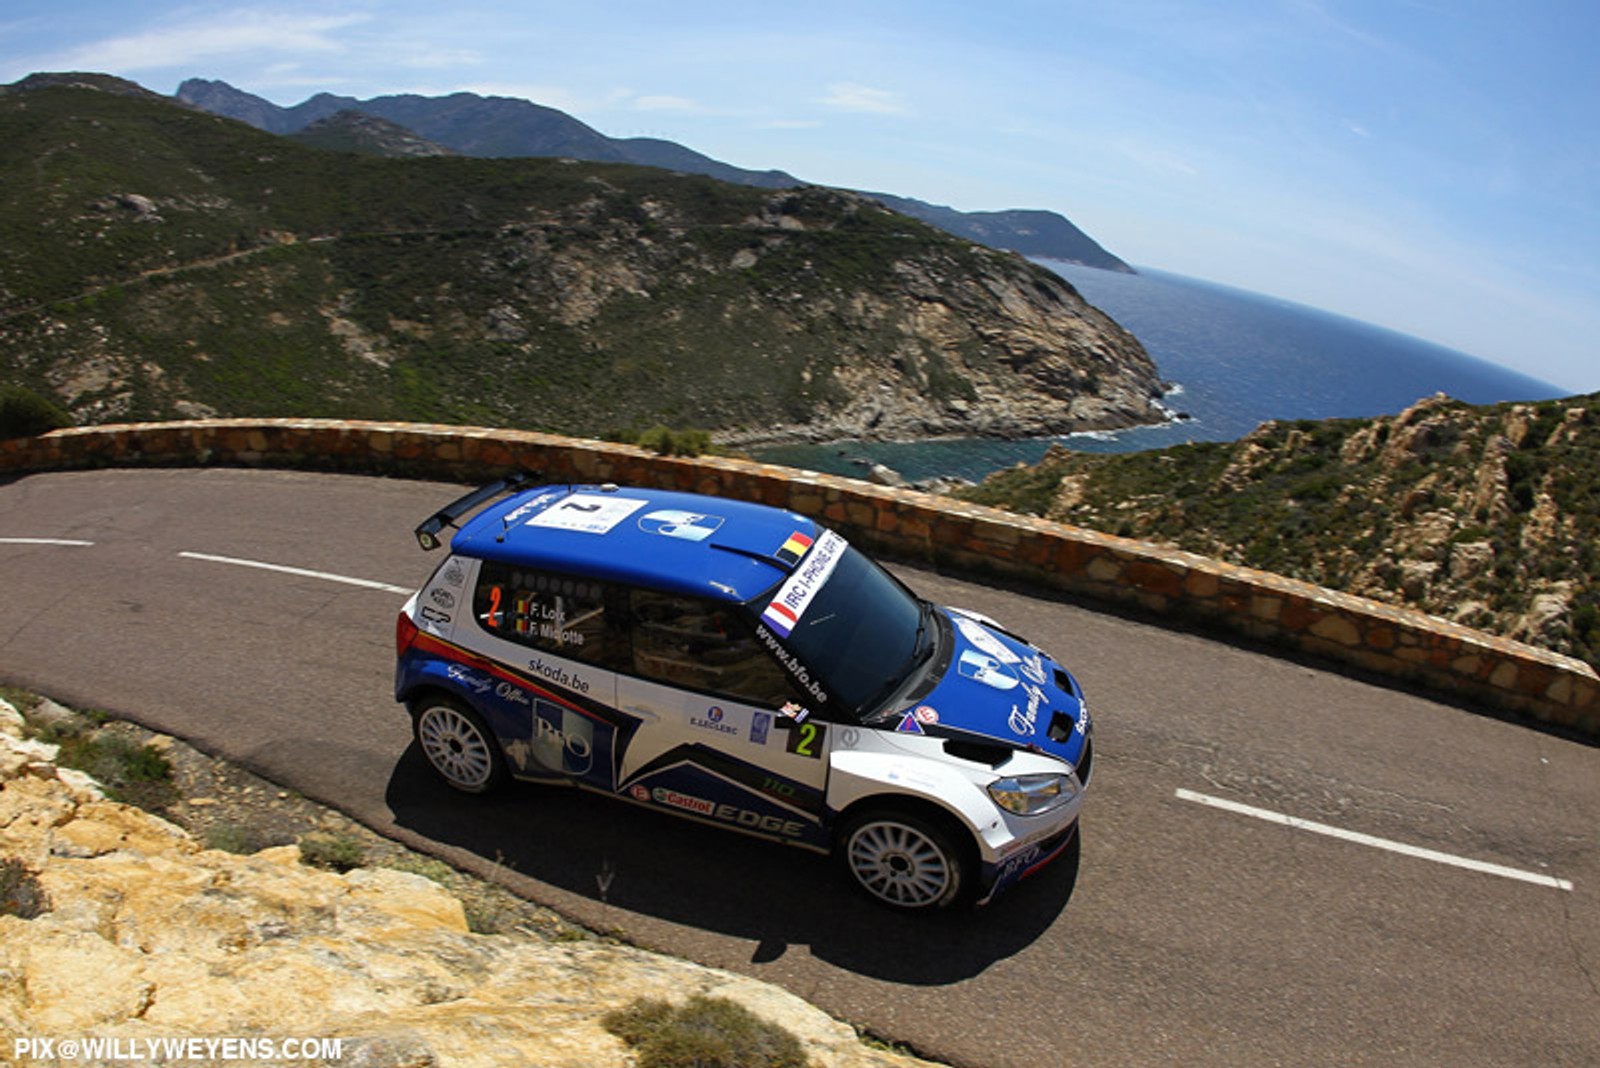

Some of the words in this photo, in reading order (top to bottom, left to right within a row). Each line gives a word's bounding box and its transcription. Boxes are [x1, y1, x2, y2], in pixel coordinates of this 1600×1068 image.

[488, 586, 501, 628] 2
[530, 603, 540, 617] F.
[784, 585, 807, 610] IRC
[528, 659, 590, 693] skoda.be
[756, 624, 828, 703] www.bfo.be
[796, 723, 817, 756] 2
[668, 792, 712, 813] Castrol
[714, 804, 806, 836] EDGE
